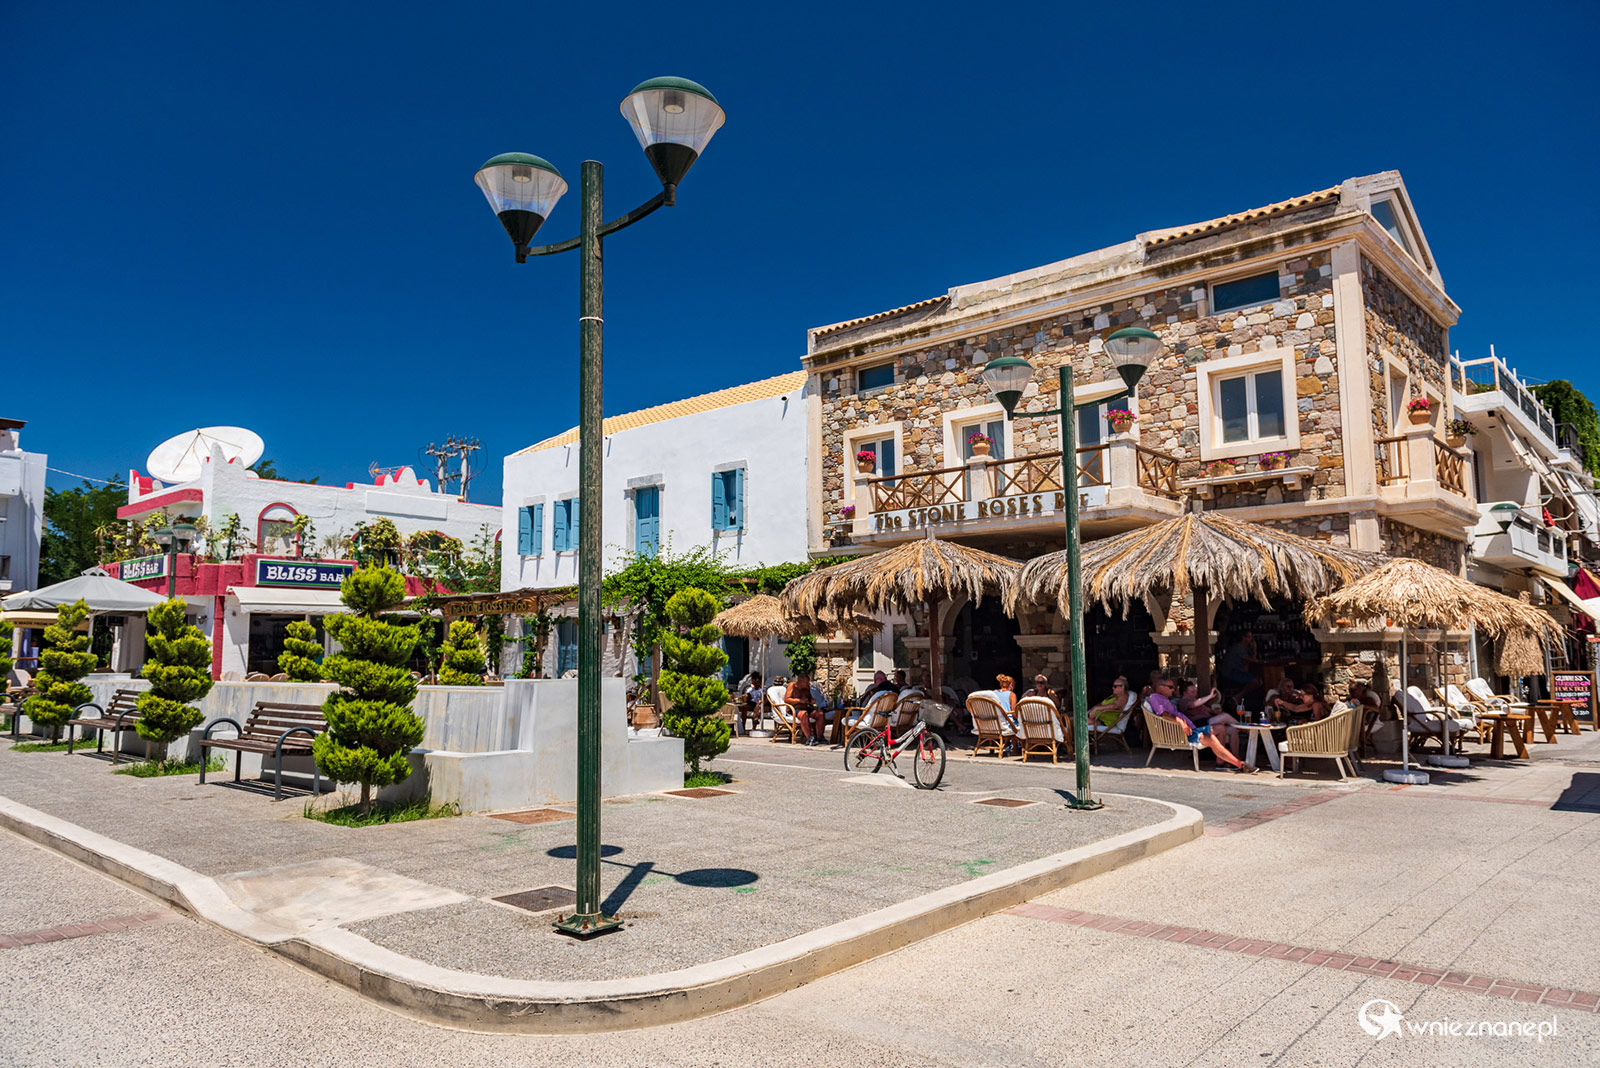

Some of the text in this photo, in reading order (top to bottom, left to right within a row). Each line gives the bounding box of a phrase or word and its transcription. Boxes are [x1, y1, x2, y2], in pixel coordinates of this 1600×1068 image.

[874, 492, 1088, 529] The STONE ROSES Br
[123, 561, 159, 579] BLISS BAR
[266, 565, 344, 582] BLISS BAR
[460, 603, 482, 614] STONE
[482, 601, 503, 613] ROSES
